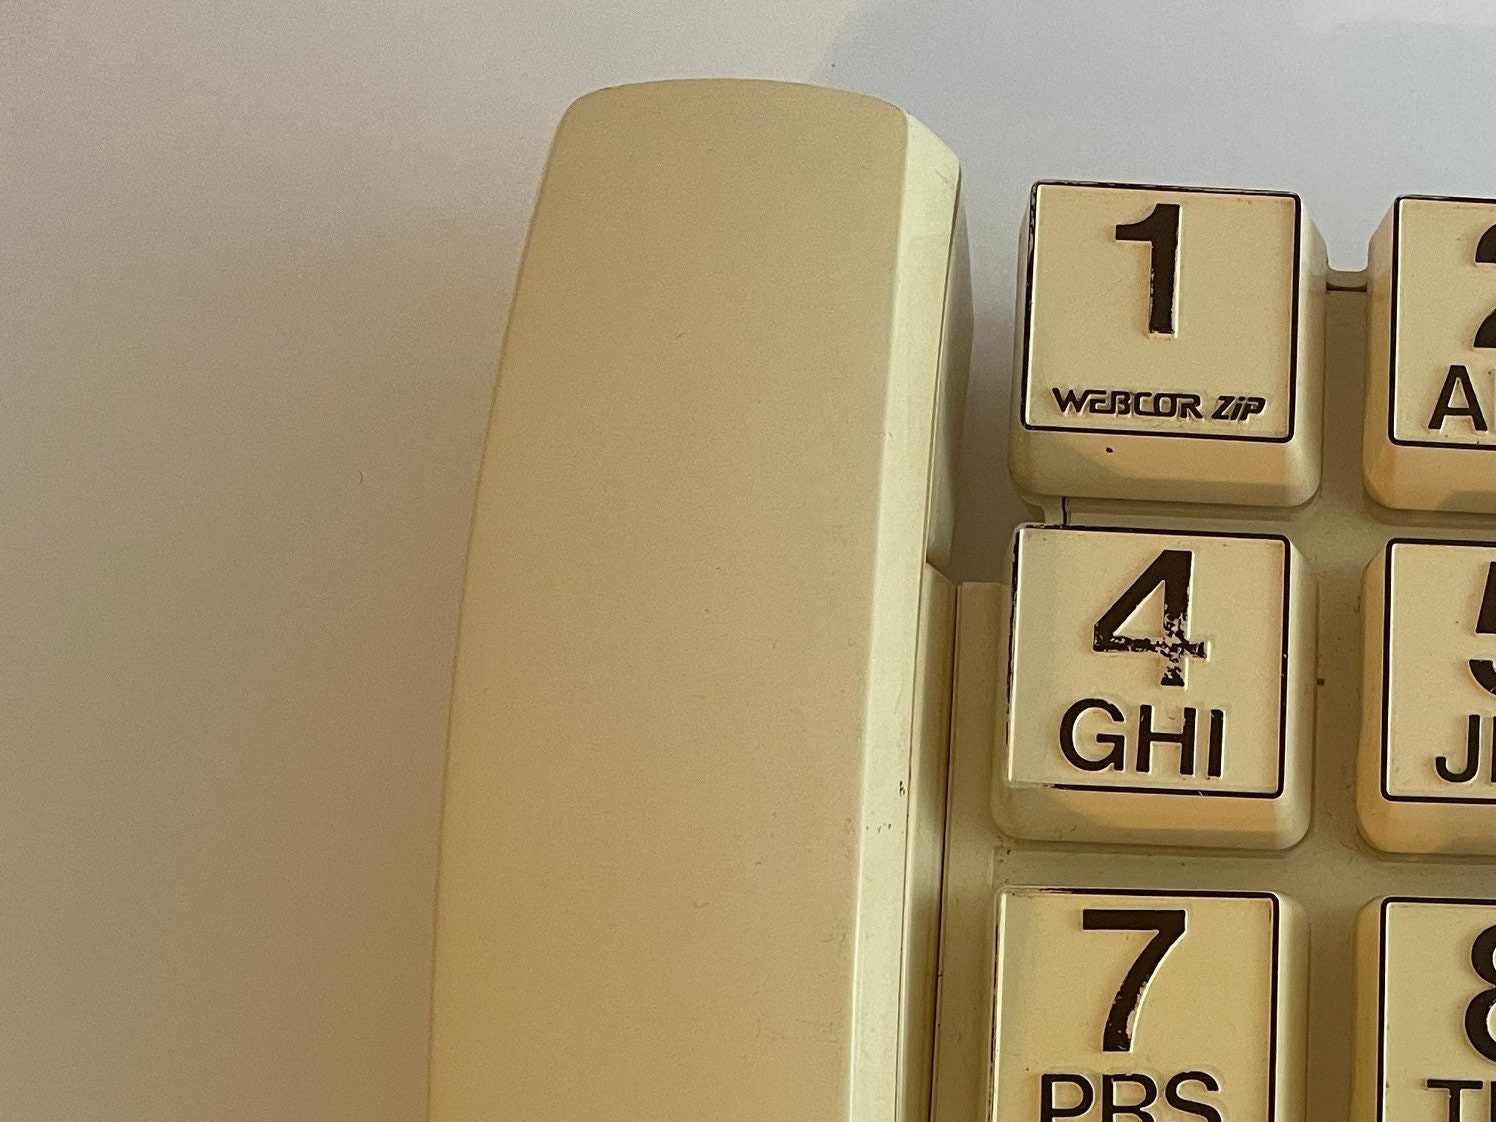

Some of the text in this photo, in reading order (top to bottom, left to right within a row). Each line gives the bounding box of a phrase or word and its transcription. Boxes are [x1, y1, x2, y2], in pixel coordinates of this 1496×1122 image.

[1115, 203, 1180, 334] 1
[1052, 388, 1203, 419] WEBCOR
[1093, 550, 1207, 687] 4
[1060, 698, 1223, 777] GHI
[1083, 909, 1185, 1052] 7
